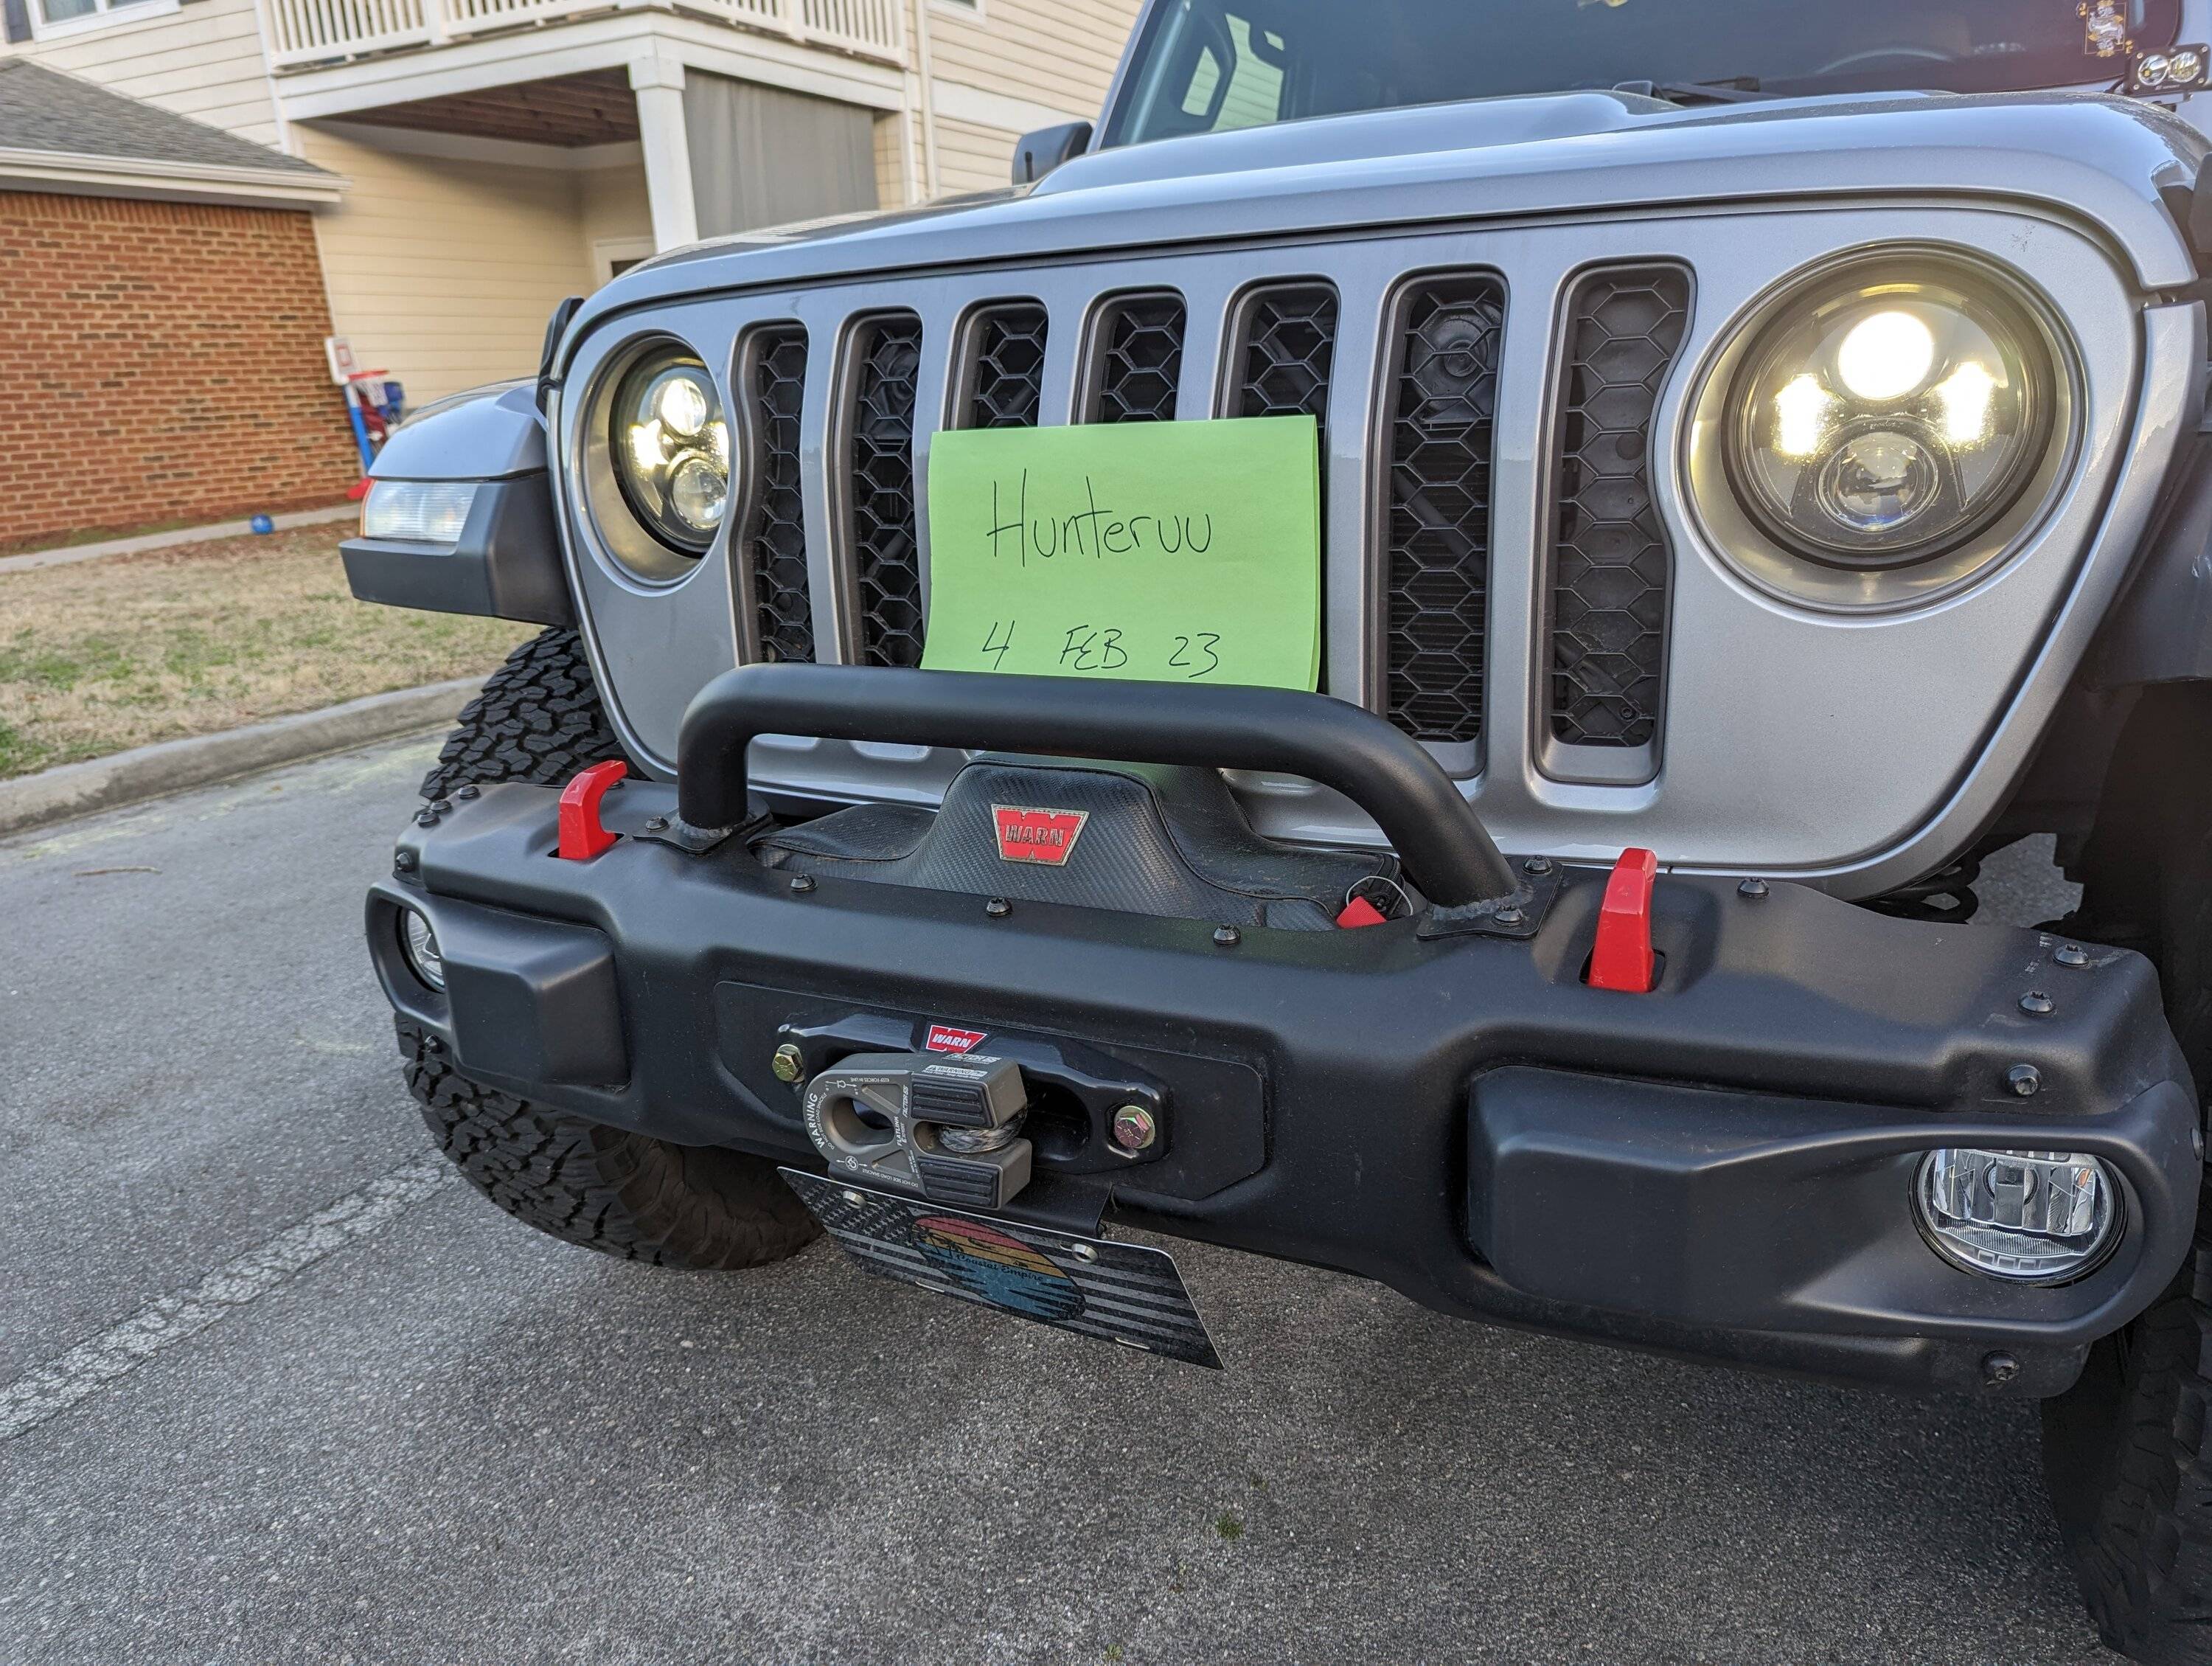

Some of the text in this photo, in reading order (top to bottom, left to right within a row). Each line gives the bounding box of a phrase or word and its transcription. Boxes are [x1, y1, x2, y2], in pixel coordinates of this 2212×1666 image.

[982, 620, 1220, 678] 4 FEB 23
[1005, 825, 1064, 847] WARN
[932, 1034, 972, 1048] WARN
[806, 1092, 825, 1148] WARNING
[956, 1254, 1044, 1281] Coastal Empire
